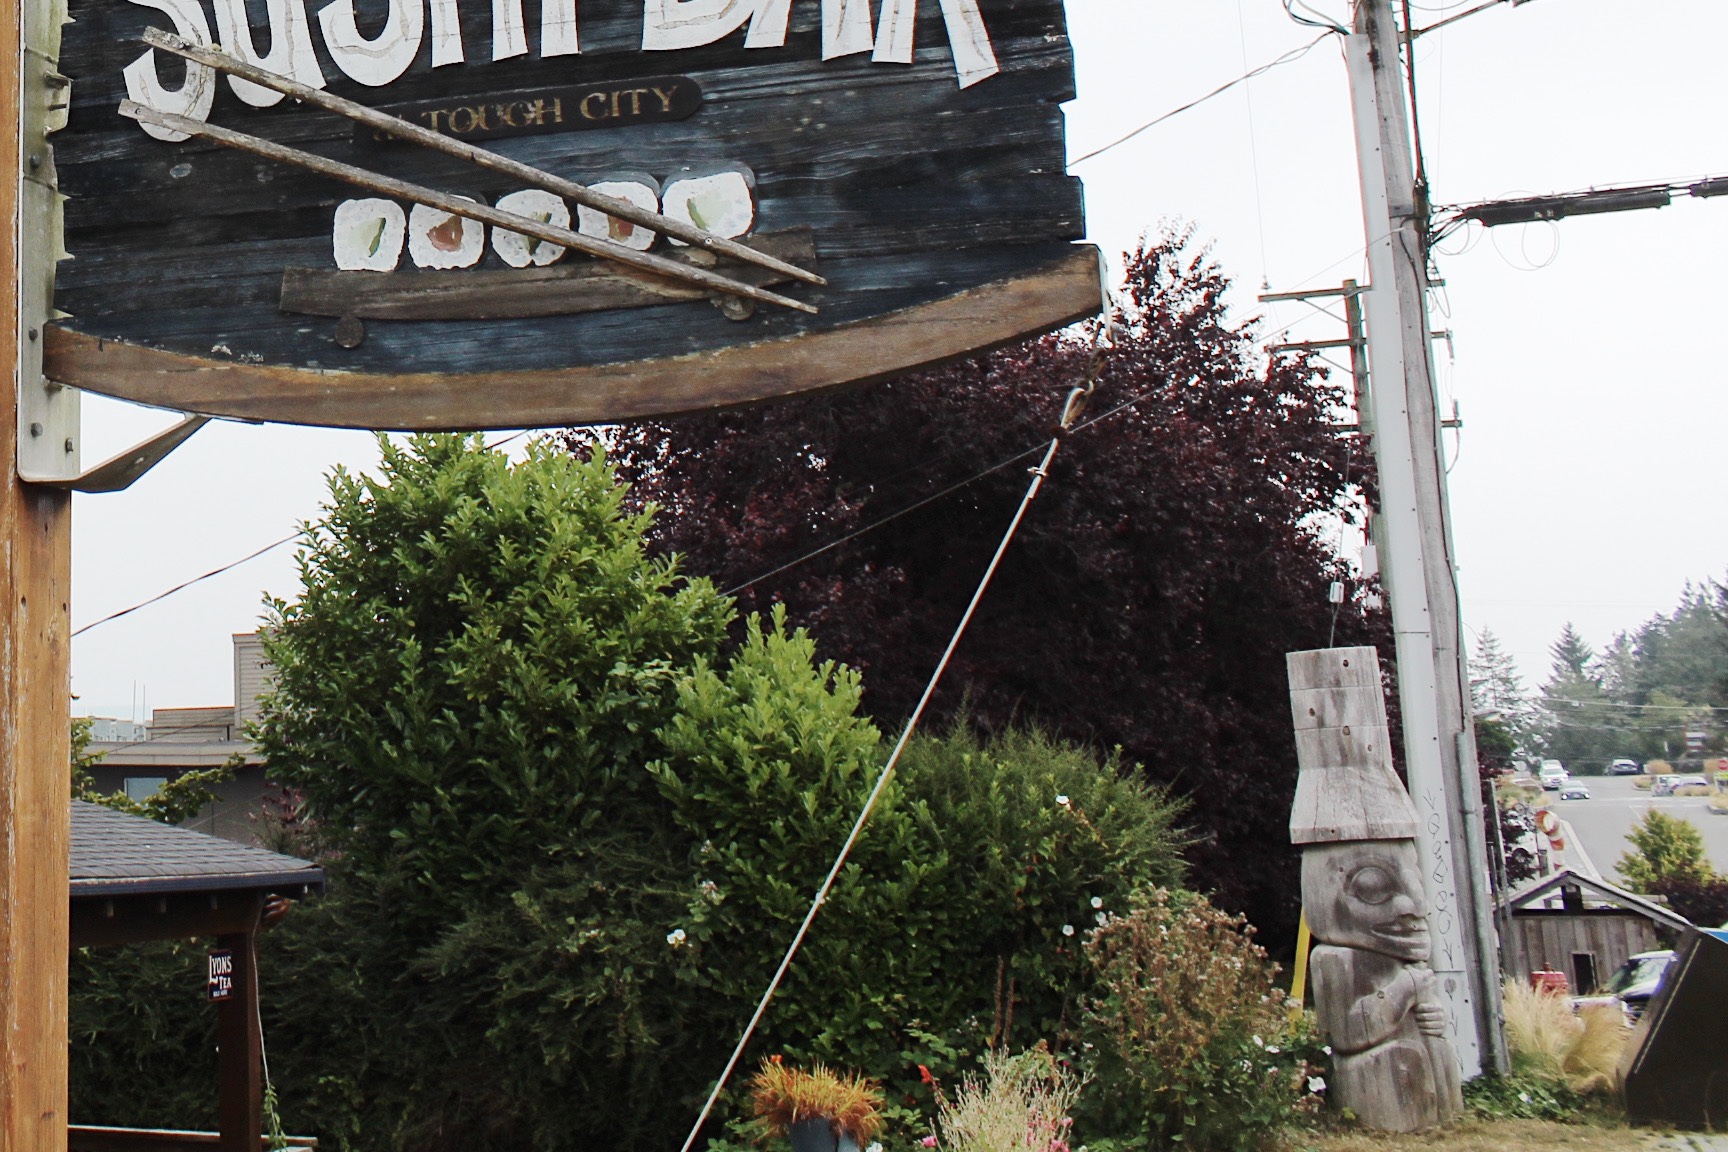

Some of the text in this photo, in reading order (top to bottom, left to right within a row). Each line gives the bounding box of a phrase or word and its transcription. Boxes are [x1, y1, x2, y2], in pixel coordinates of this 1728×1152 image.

[422, 97, 564, 134] TOUGH
[580, 84, 679, 121] CITY
[219, 975, 232, 990] TEA
